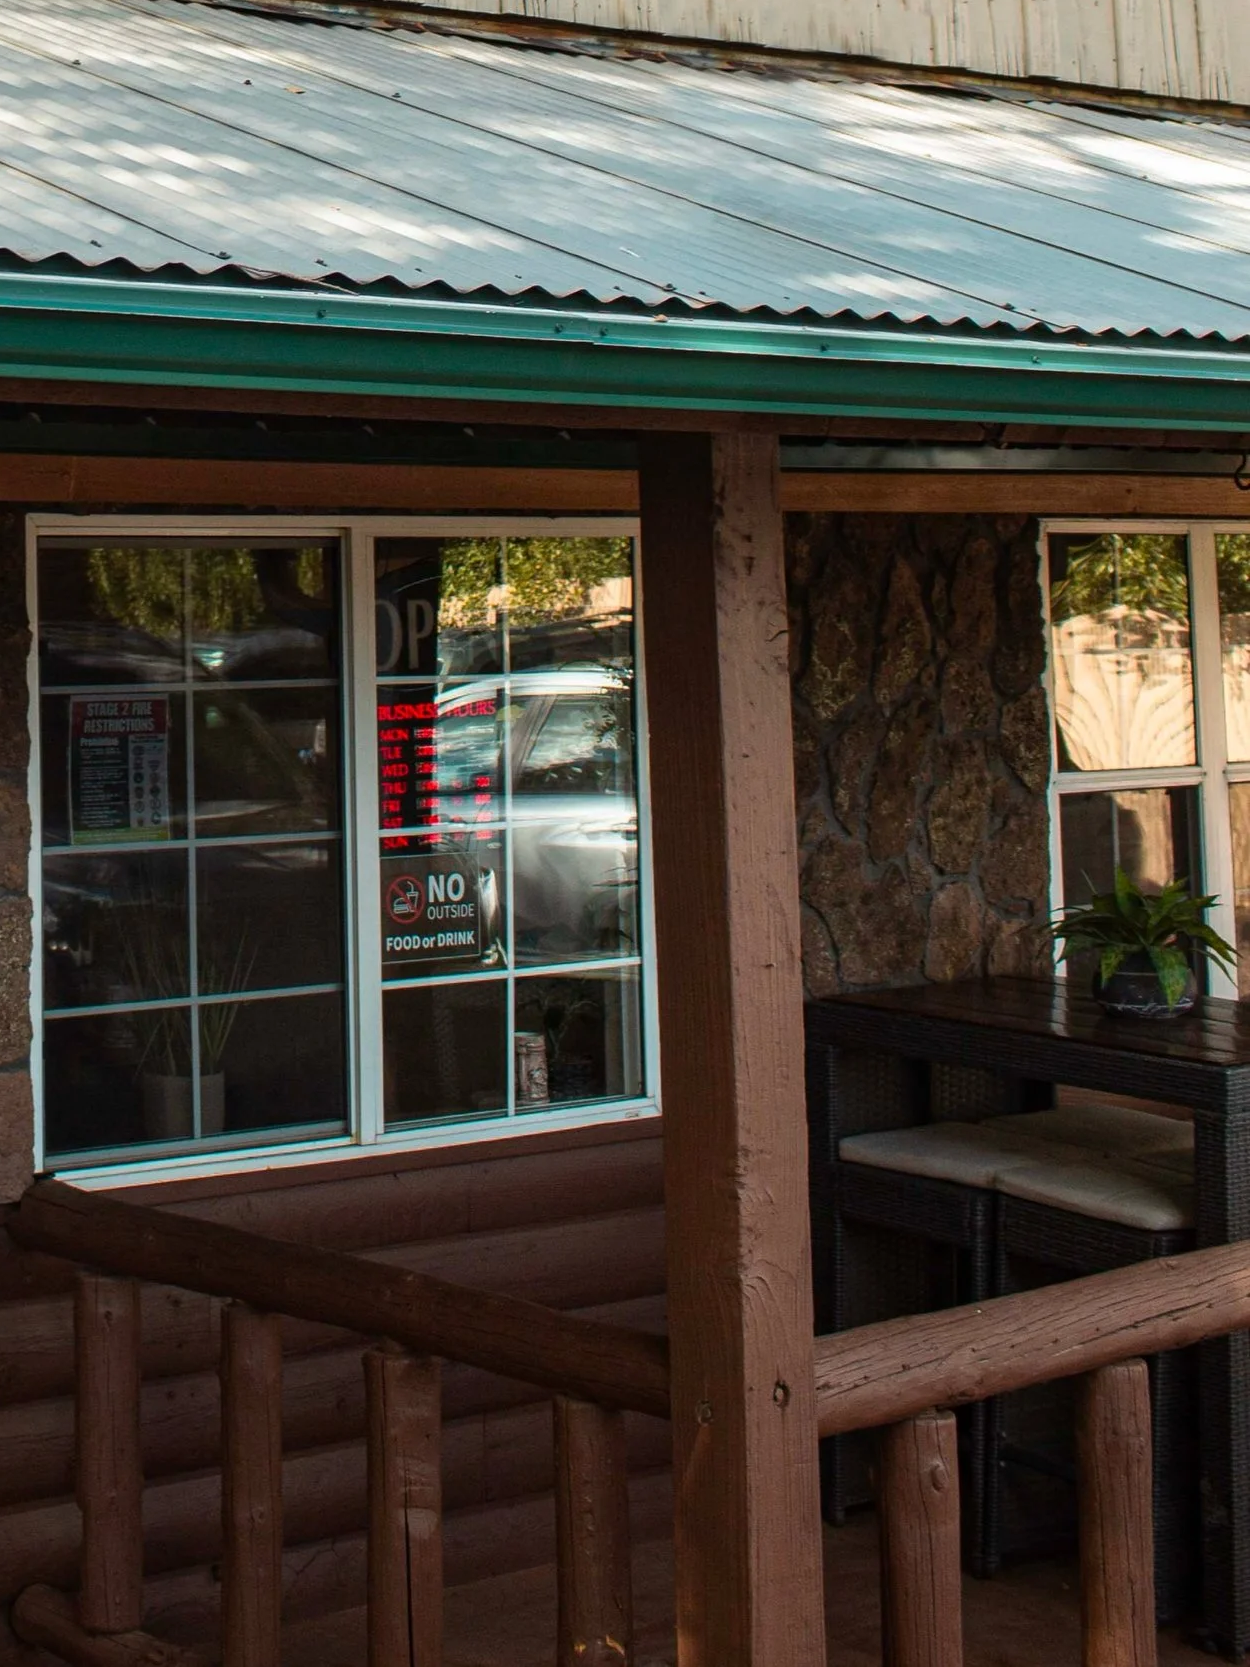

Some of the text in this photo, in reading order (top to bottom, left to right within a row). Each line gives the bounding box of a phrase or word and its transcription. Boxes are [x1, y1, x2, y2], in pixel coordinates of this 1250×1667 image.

[86, 701, 152, 716] STAGE 2 FIRE
[83, 717, 155, 734] RESTRICTIONS
[427, 872, 465, 903] NO
[427, 903, 475, 921] OUTSIDE
[385, 930, 476, 952] FOOD or DRINK
